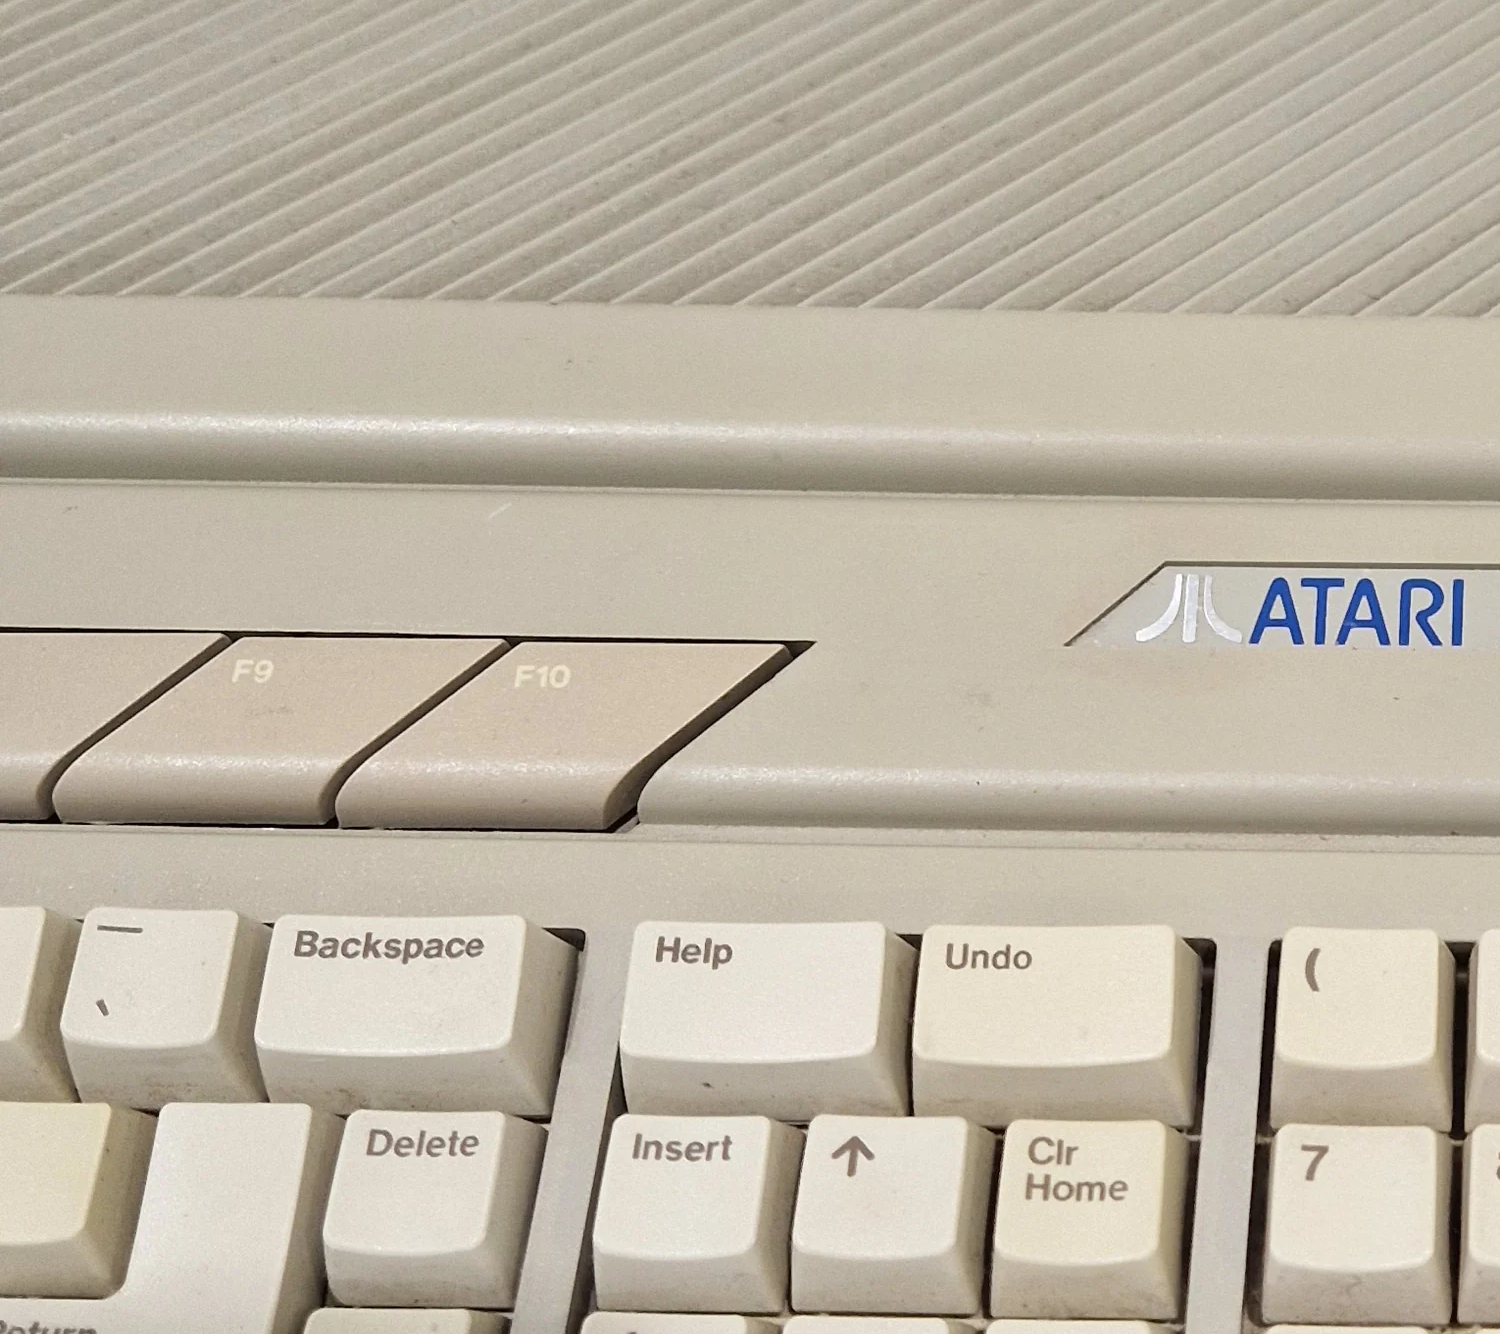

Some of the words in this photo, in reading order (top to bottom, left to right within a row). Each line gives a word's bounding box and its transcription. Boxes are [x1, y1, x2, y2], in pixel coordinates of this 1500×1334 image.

[1248, 576, 1465, 646] ATARI
[231, 659, 275, 684] F9
[514, 664, 571, 689] F10
[293, 930, 485, 965] Backspace
[655, 935, 733, 970] Help
[945, 942, 1033, 970] Undo
[365, 1128, 480, 1158] Delete
[632, 1132, 733, 1162] Insert
[1027, 1136, 1079, 1166] Clr
[1300, 1144, 1330, 1182] 7
[1025, 1173, 1128, 1202] Home
